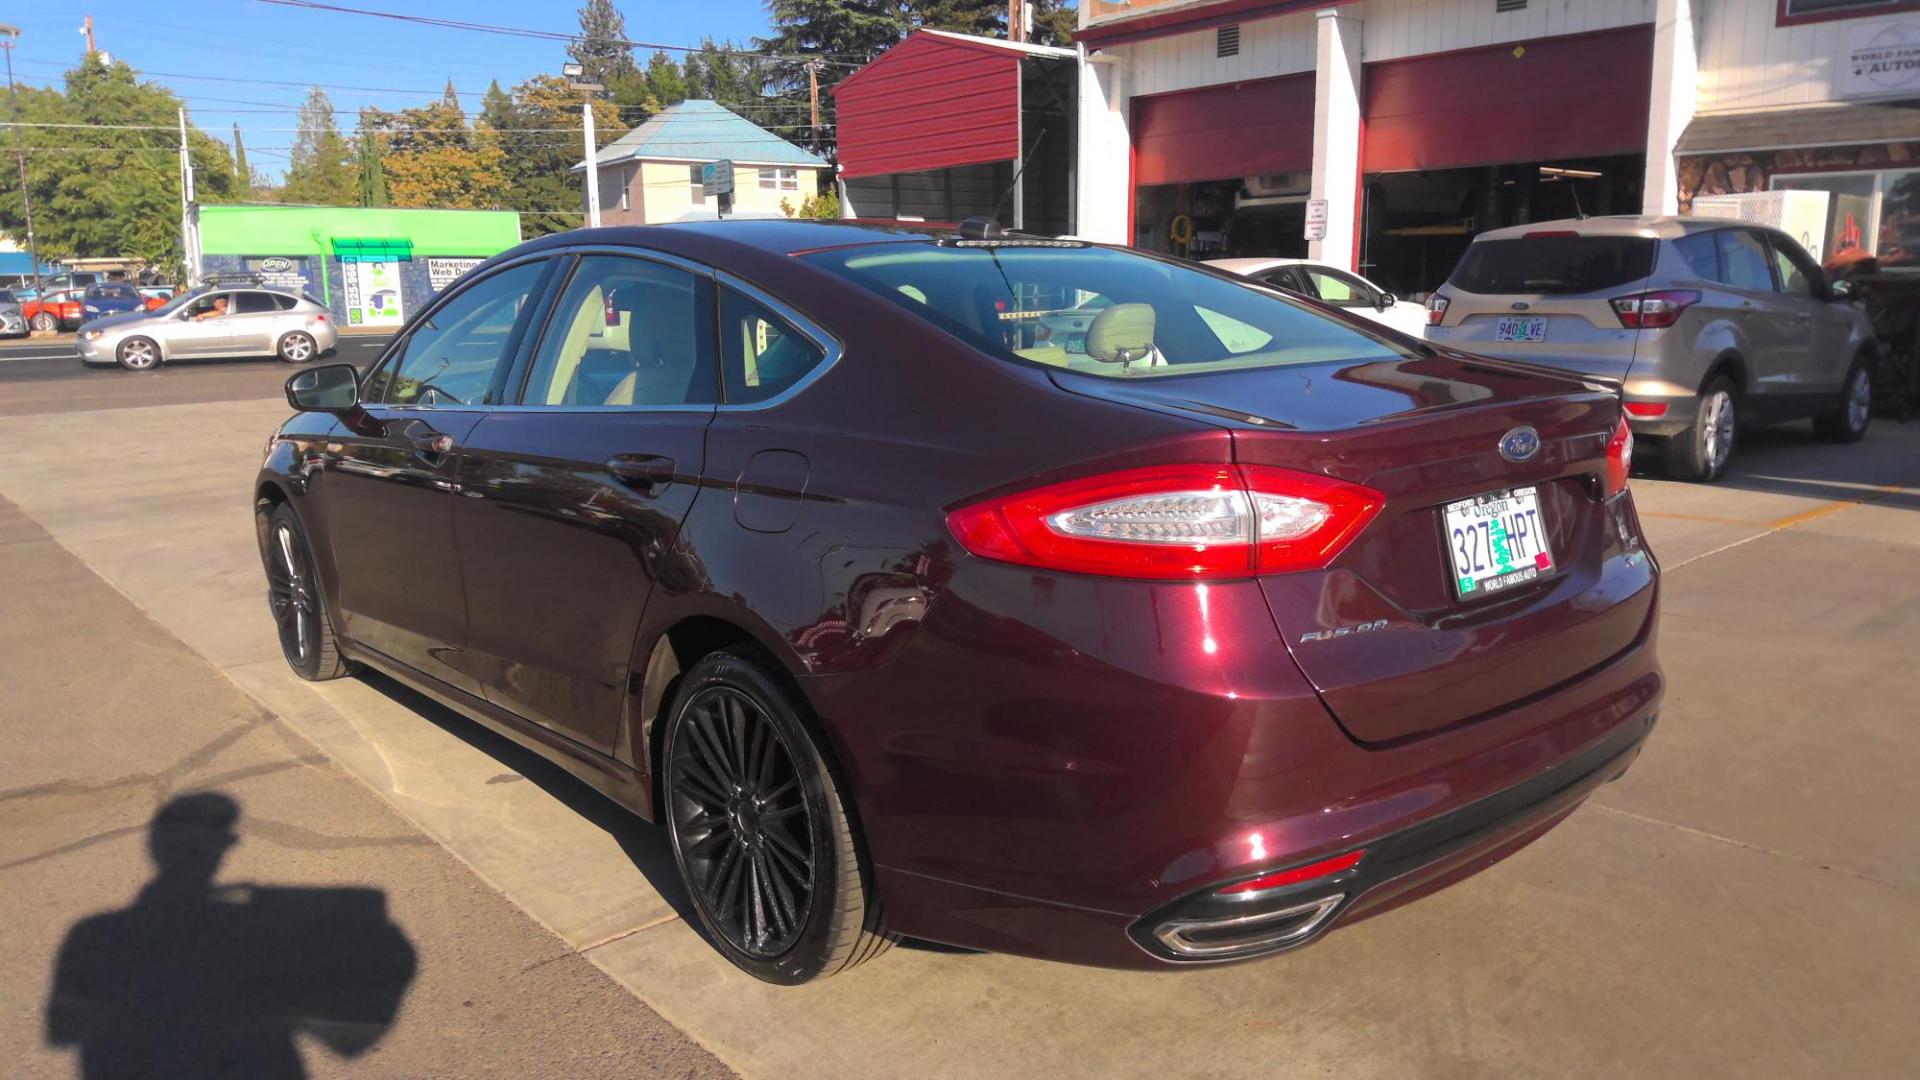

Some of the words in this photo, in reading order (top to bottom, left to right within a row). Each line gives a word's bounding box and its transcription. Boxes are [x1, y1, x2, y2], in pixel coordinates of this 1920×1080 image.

[1851, 51, 1893, 62] WORLD
[1499, 322, 1518, 336] 940
[1523, 322, 1543, 336] LVE
[1474, 499, 1509, 518] Oregon
[1453, 520, 1494, 575] 327
[1502, 509, 1542, 562] HPT
[1484, 578, 1503, 591] WORLD
[1503, 570, 1524, 587] FAMOUS
[1524, 567, 1537, 581] AUTO
[1299, 619, 1388, 643] FUSON
